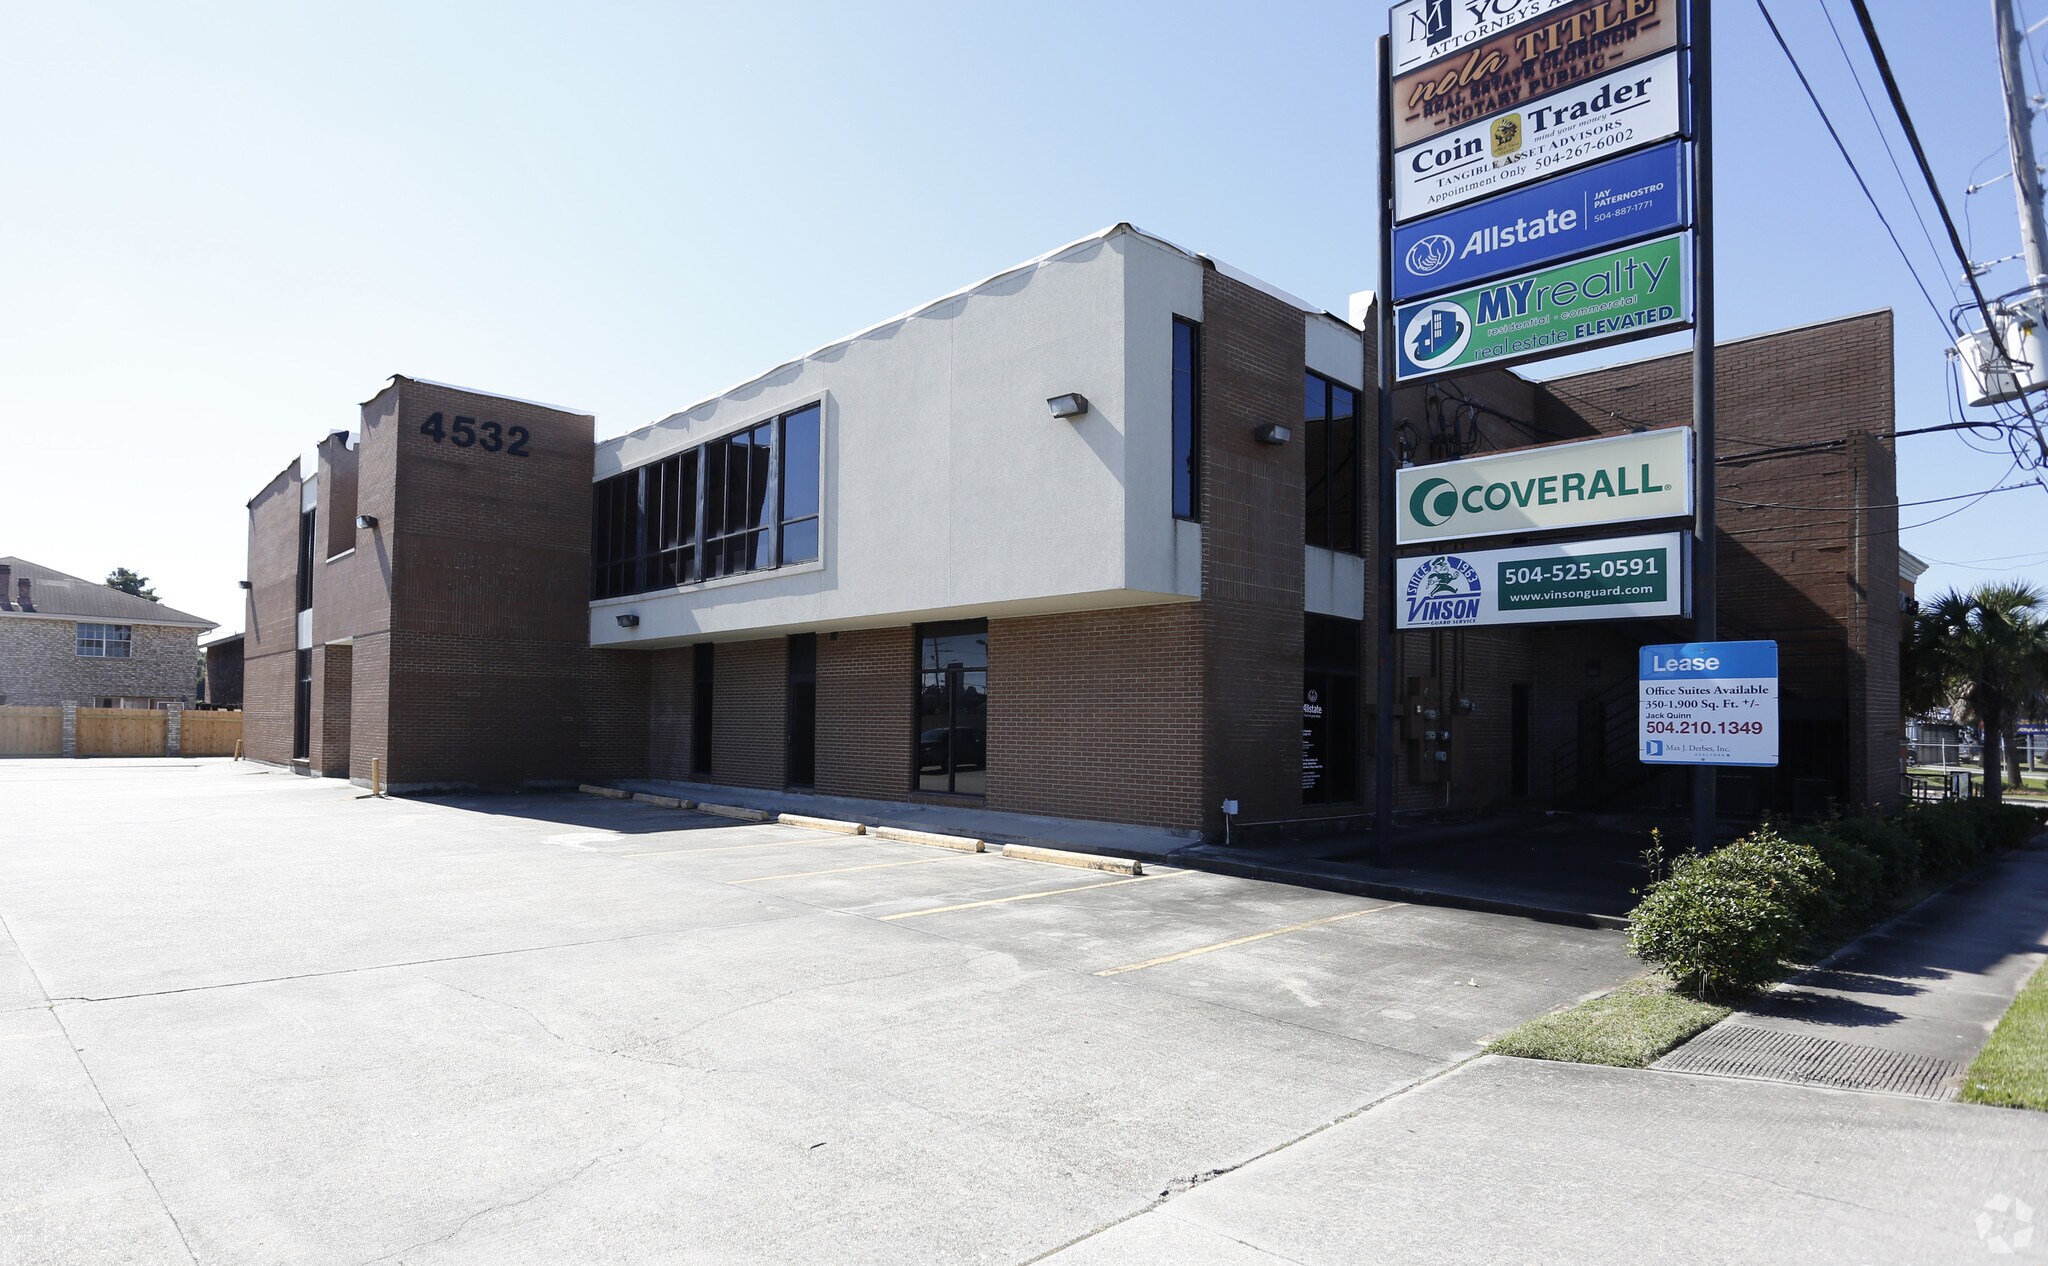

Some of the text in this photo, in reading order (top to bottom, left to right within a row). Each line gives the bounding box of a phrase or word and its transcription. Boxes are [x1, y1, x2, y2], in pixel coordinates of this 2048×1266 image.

[1429, 2, 1539, 58] ATTORNEYS
[1409, 0, 1655, 108] nola TITLE
[1423, 93, 1466, 118] REAL
[1470, 61, 1535, 98] ESTATE
[1448, 54, 1605, 125] NOTARY PUBLIC
[1412, 77, 1651, 173] Coin Trader
[1534, 113, 1608, 142] mind your money
[1428, 175, 1496, 204] Appointment
[1500, 166, 1527, 180] Only
[1535, 128, 1634, 170] 504-267-6002
[1437, 160, 1500, 187] TANGIBLE
[1503, 145, 1546, 166] ASSET
[1549, 119, 1622, 151] ADVISORS
[1594, 188, 1611, 200] JAY
[1594, 182, 1664, 208] PATERNOSTRO
[1594, 200, 1653, 222] 504-887-1771
[1460, 209, 1577, 259] Allstate
[1487, 294, 1638, 336] residential commercial
[1575, 305, 1674, 338] ELEVATED
[420, 412, 529, 457] 4532
[1408, 560, 1478, 593] SINCE 1963
[1505, 557, 1658, 584] 504-525-0591
[1406, 596, 1480, 622] VINSON
[1510, 584, 1653, 603] www.vinsonguard.com
[1653, 655, 1720, 672] Lease
[1645, 685, 1769, 695] Office Suites Available
[1645, 700, 1698, 709] 350-1,900
[1701, 699, 1719, 711] Sq.
[1722, 700, 1738, 709] Ft.
[1646, 721, 1763, 735] 504.210.1349
